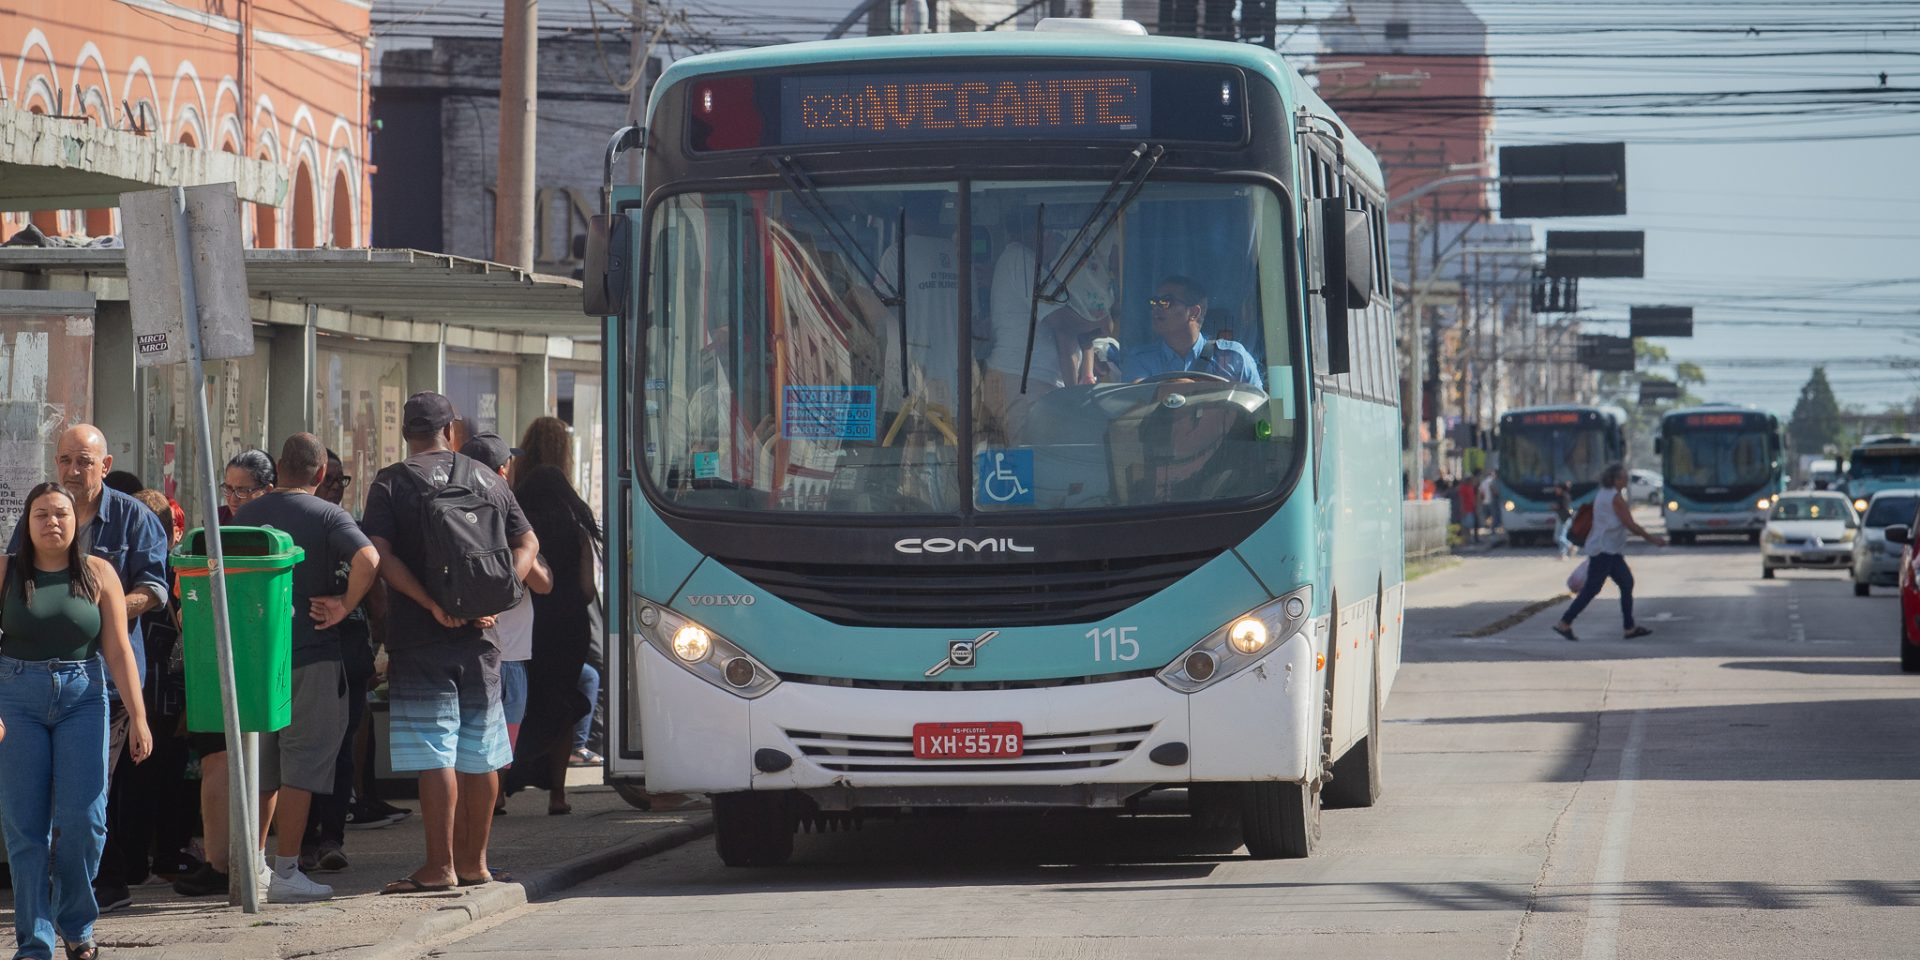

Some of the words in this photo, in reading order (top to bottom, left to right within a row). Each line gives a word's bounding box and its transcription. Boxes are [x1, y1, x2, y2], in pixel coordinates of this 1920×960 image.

[139, 334, 165, 344] MRCD
[141, 342, 167, 352] MRCD
[800, 391, 853, 402] TARIFA
[894, 537, 1035, 554] COMIL
[687, 594, 756, 606] VOLVO
[1085, 626, 1140, 661] 115
